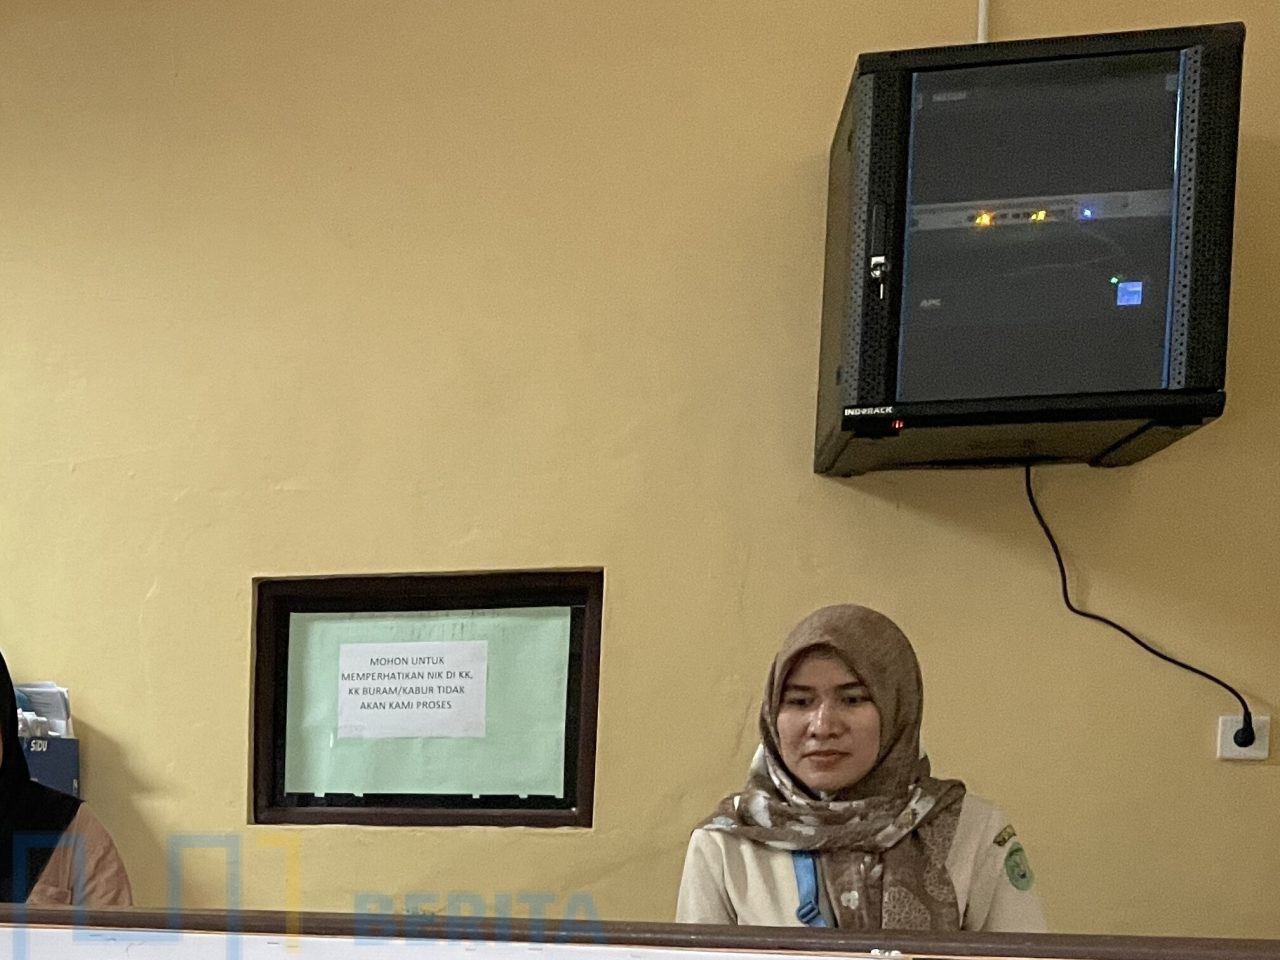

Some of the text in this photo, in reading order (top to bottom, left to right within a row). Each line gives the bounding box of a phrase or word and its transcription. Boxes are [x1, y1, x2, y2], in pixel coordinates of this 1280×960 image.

[370, 656, 444, 666] MOHON UNTUK
[342, 672, 424, 681] MEMPERHATIKAN
[427, 672, 443, 680] NIK
[446, 671, 456, 679] DI
[363, 686, 433, 695] BURAM/KABUR
[438, 686, 465, 694] TIDAK
[360, 701, 452, 710] AKAN KAMI PROSES
